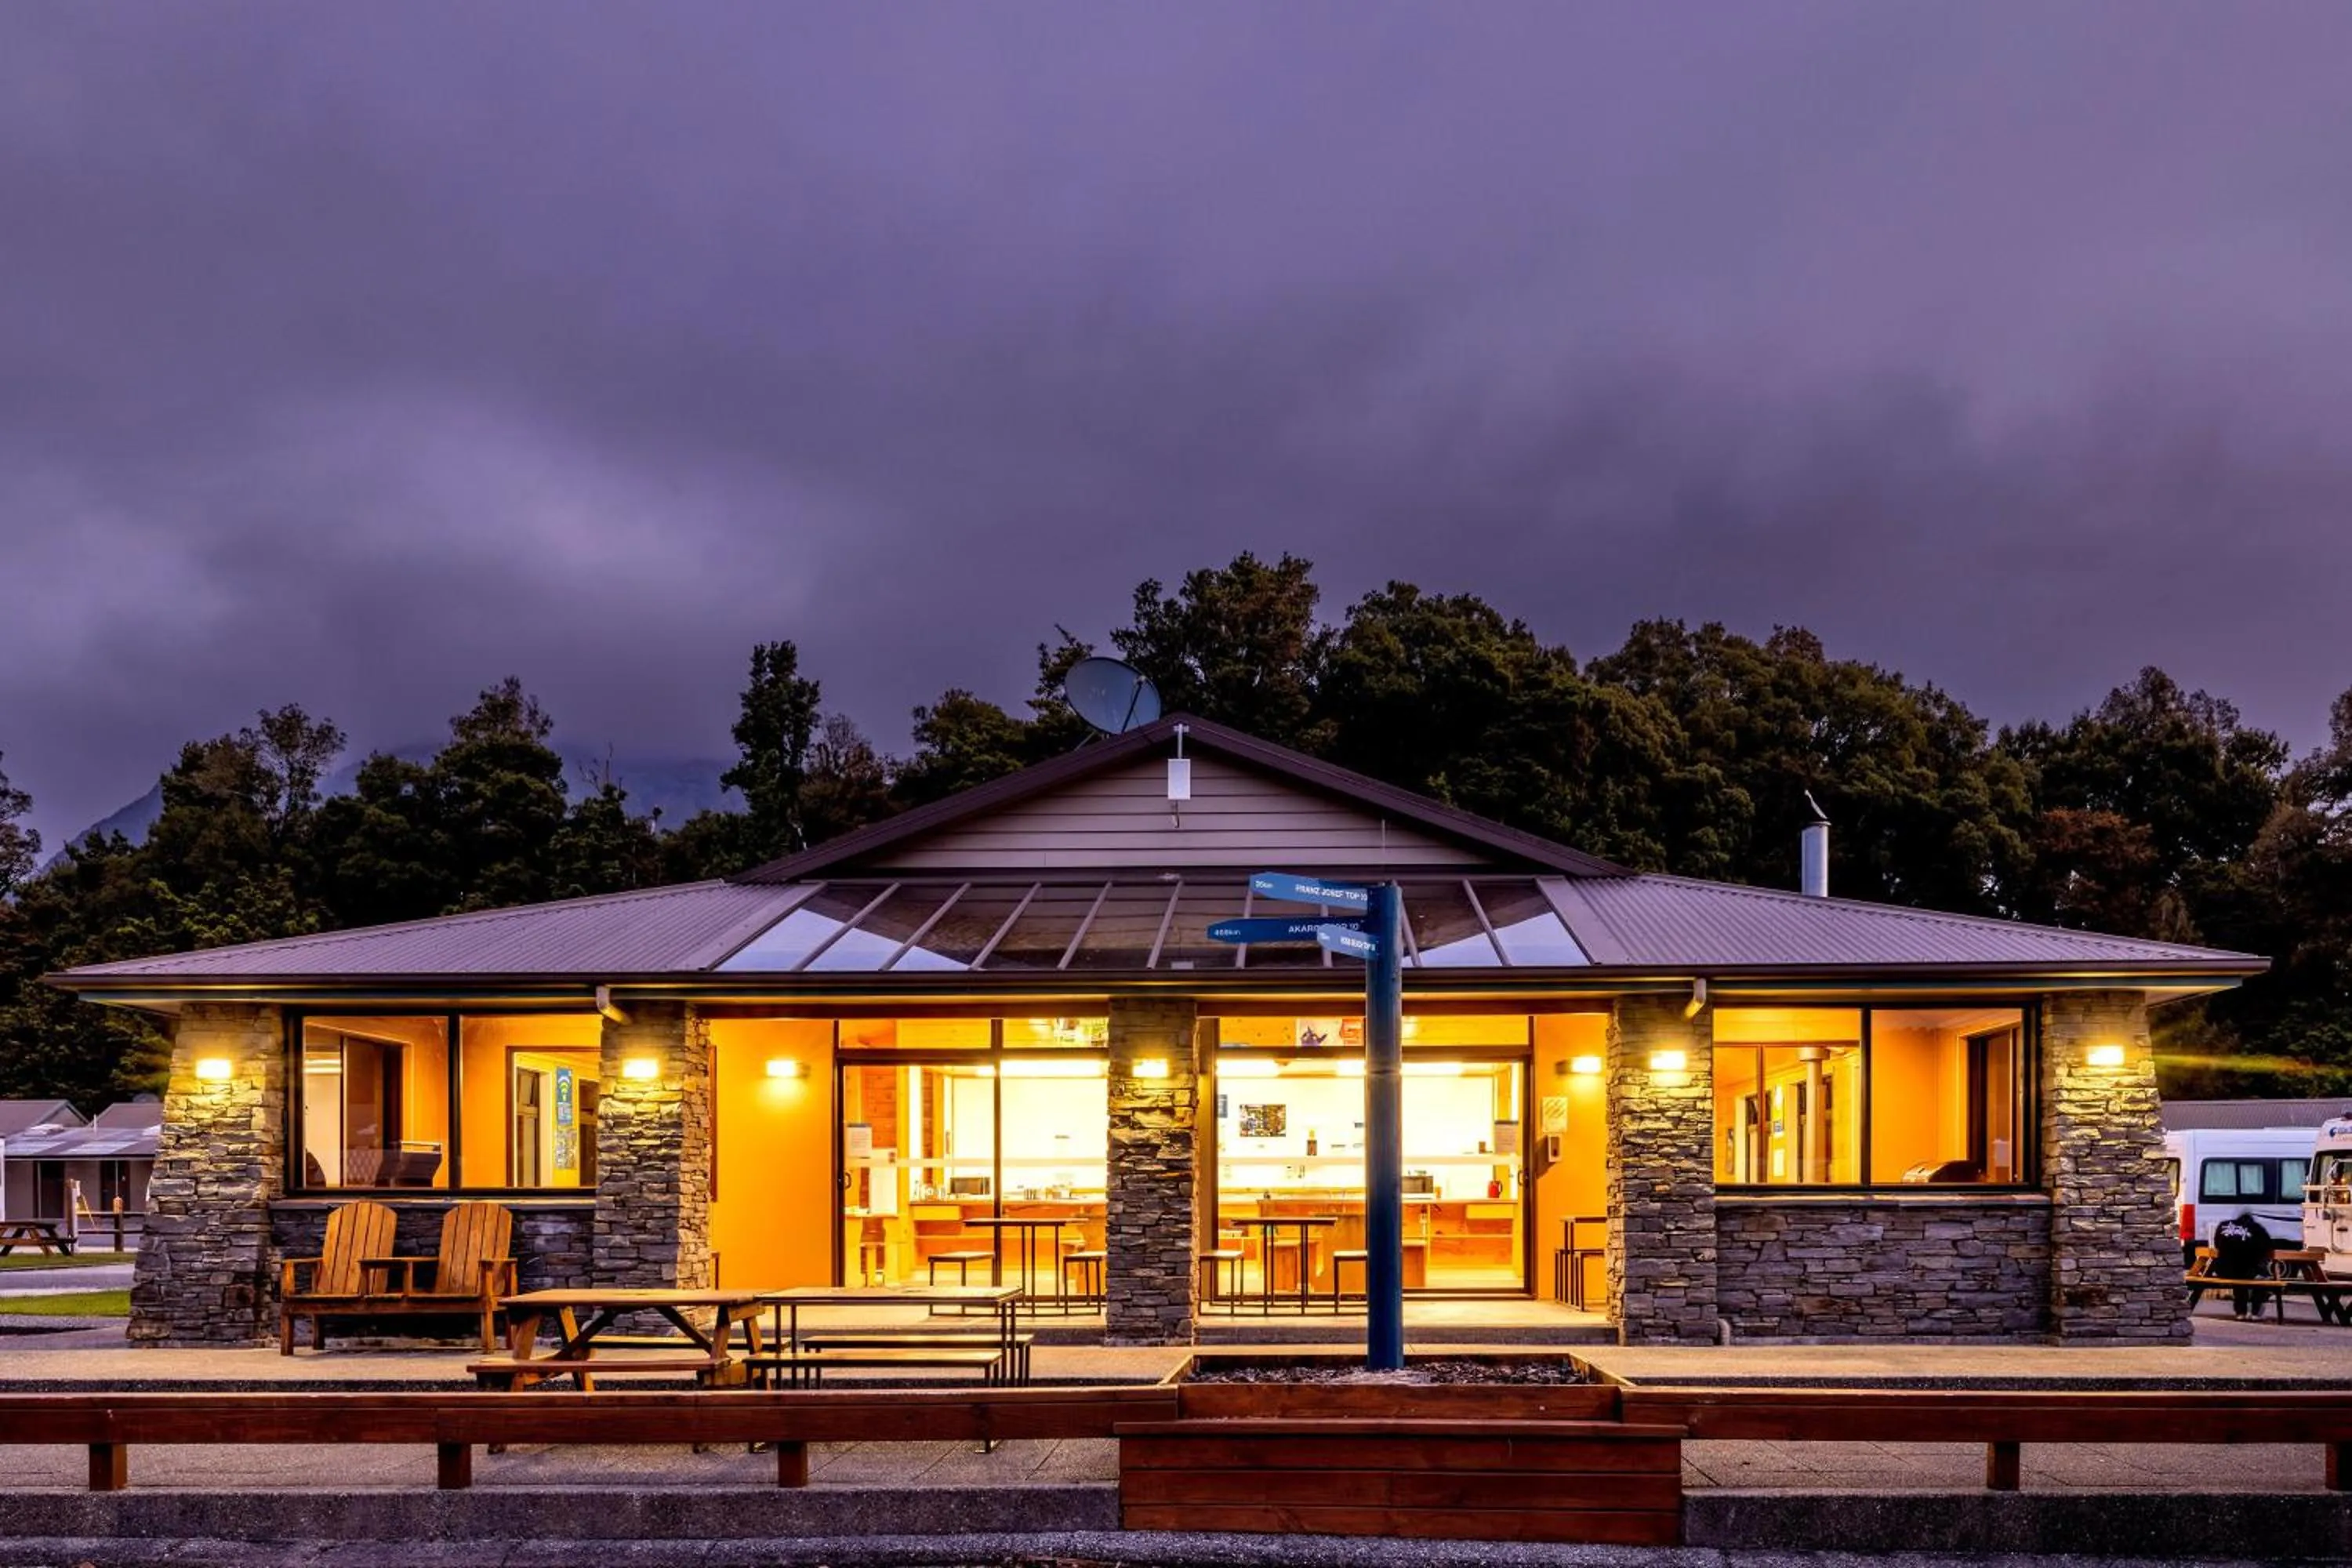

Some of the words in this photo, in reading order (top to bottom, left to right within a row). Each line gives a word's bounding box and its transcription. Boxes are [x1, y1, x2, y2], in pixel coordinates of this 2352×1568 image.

[1294, 884, 1320, 895] FRANZ
[1321, 887, 1344, 898] JOSEF
[1345, 890, 1359, 900] TOP
[1288, 924, 1319, 934] AKARO
